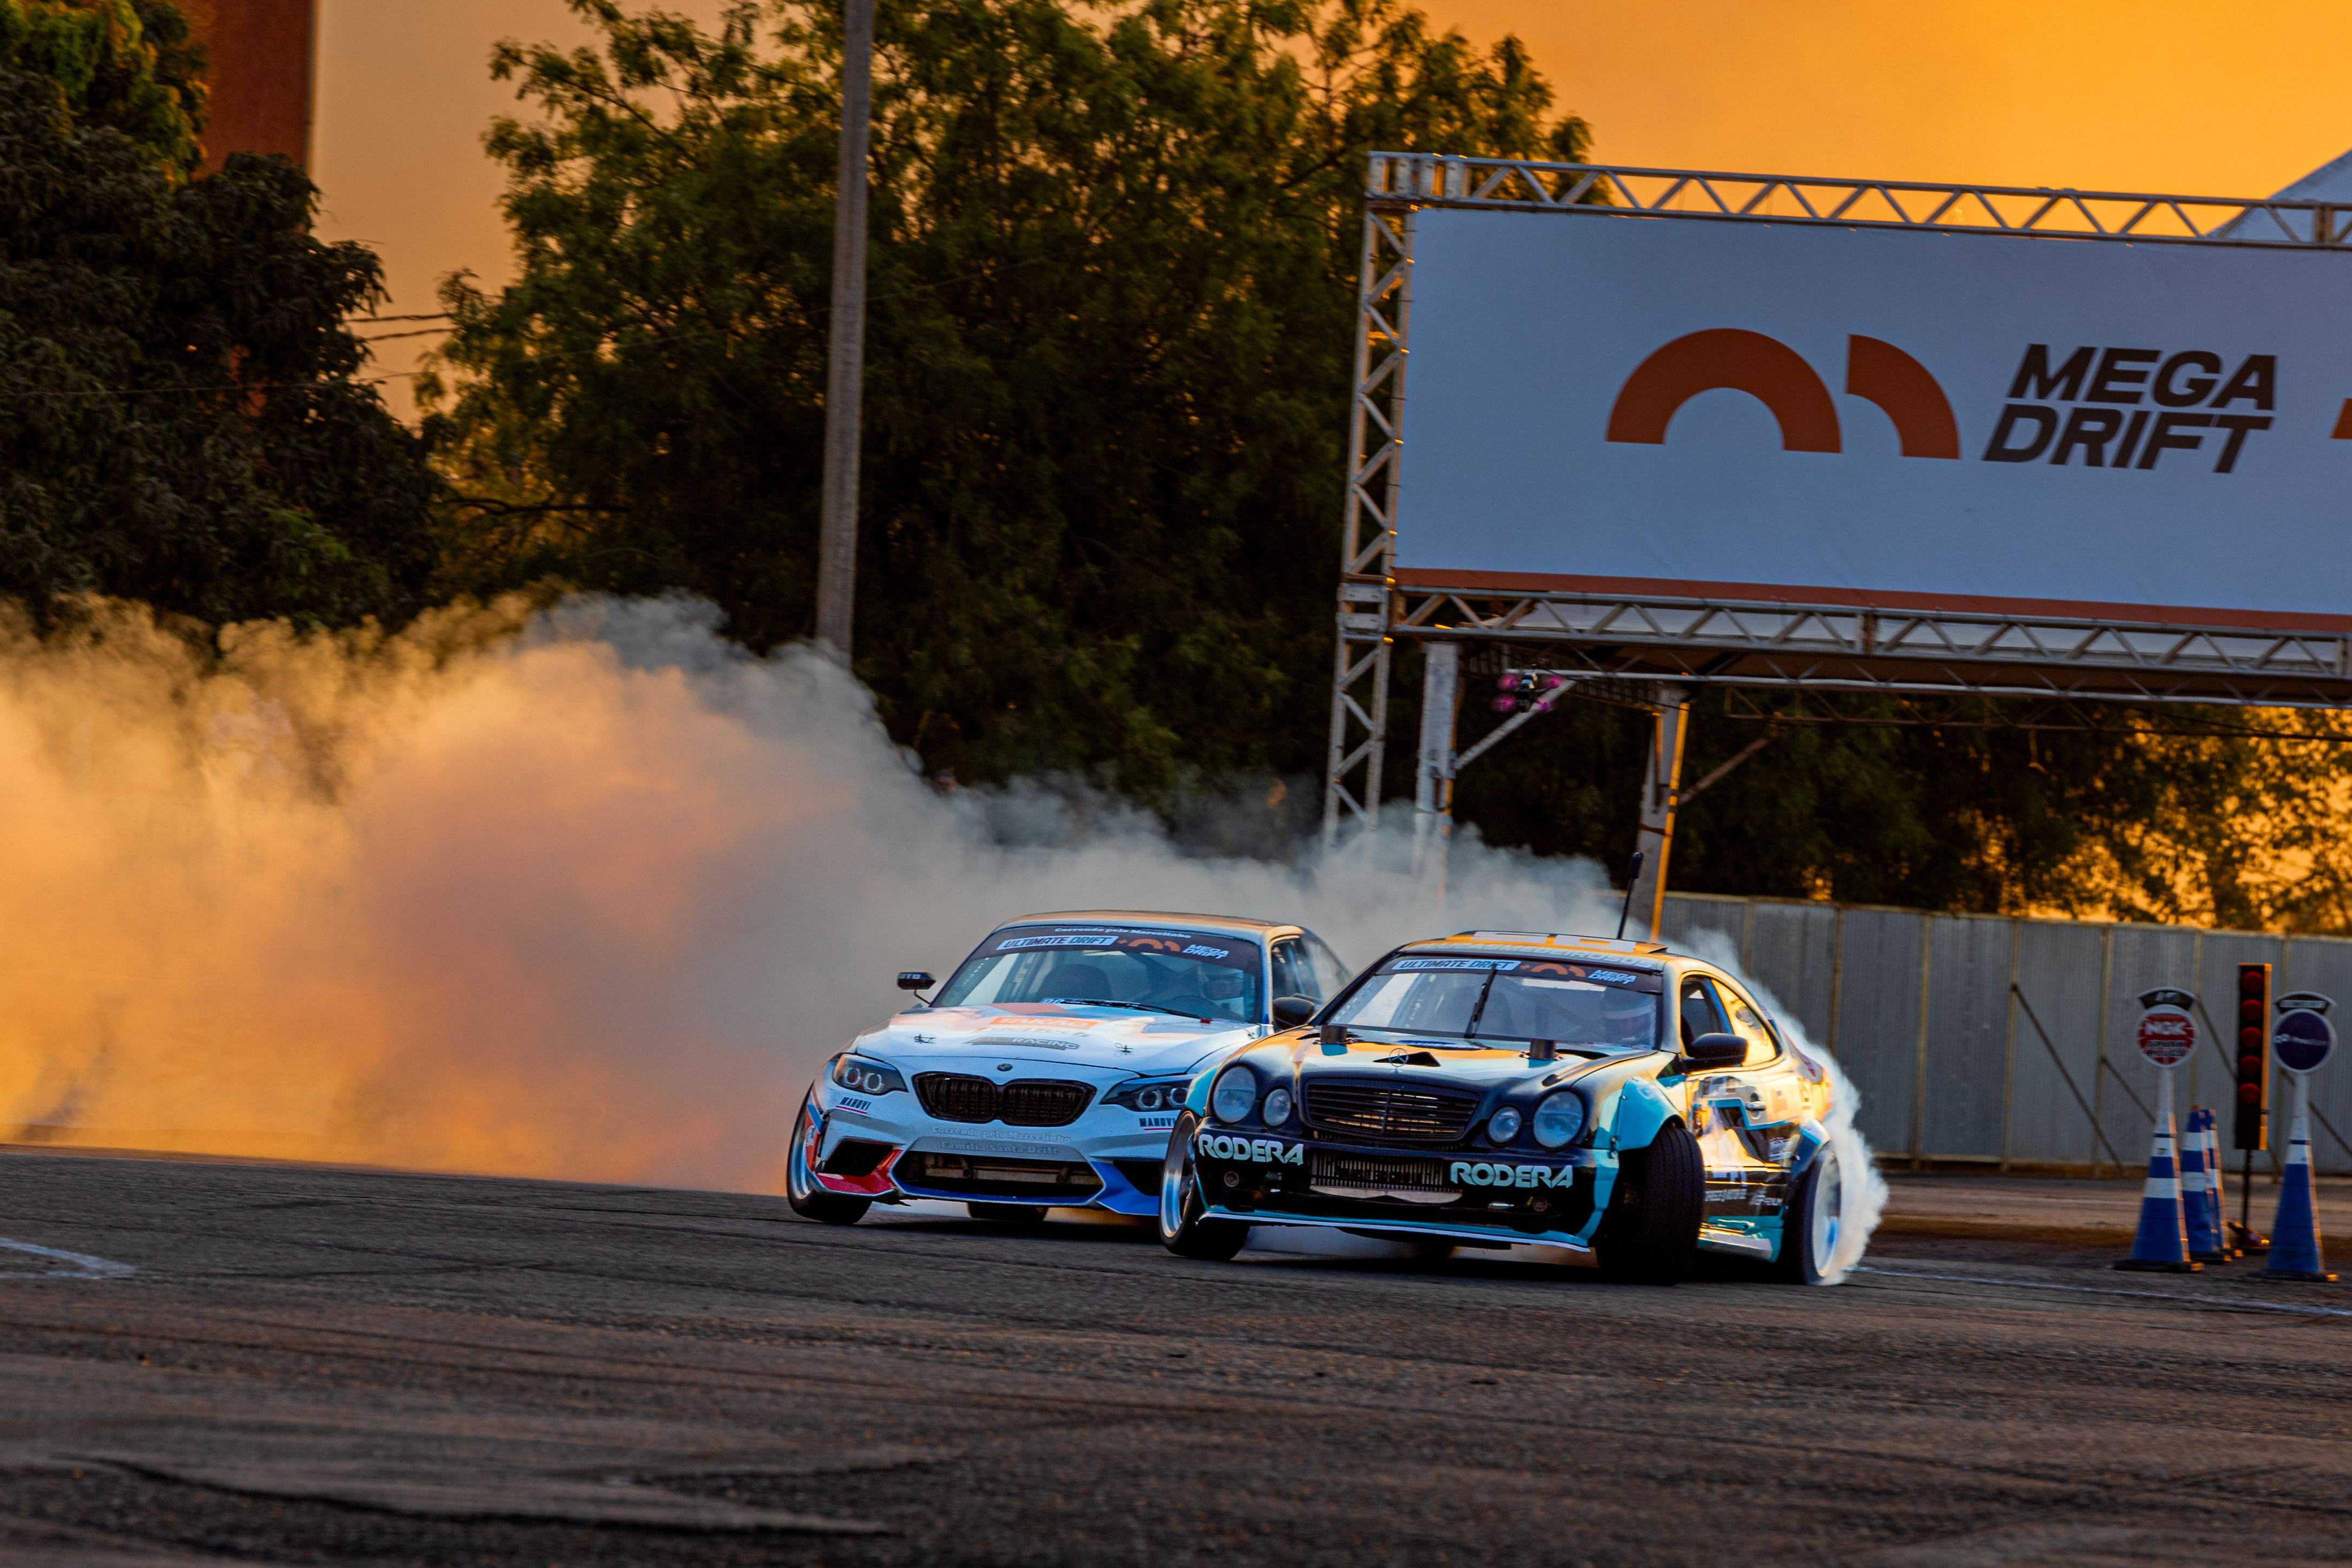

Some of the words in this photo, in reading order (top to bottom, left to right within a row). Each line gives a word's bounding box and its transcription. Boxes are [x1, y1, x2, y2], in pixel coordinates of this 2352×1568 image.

[2006, 343, 2277, 411] MEGA
[1981, 404, 2276, 474] DRIFT
[1003, 937, 1069, 947] ULTIMATE
[1068, 937, 1111, 945] DRIFT
[1182, 948, 1228, 959] DRIFT
[1187, 944, 1230, 955] MEGA
[1400, 960, 1470, 969] ULTIMATE
[1587, 974, 1635, 984] DRIFT
[1593, 970, 1637, 980] MEGA
[1000, 1018, 1089, 1027] TAKAO
[2145, 1021, 2186, 1035] NGK
[1011, 1038, 1078, 1049] RACING
[932, 1126, 980, 1136] Correndo
[983, 1129, 1006, 1138] pelo
[1008, 1131, 1071, 1143] Marcelinho
[989, 1144, 1024, 1153] Santa
[1027, 1146, 1059, 1155] Drift
[1198, 1134, 1304, 1165] RODERA
[1450, 1162, 1573, 1188] RODERA
